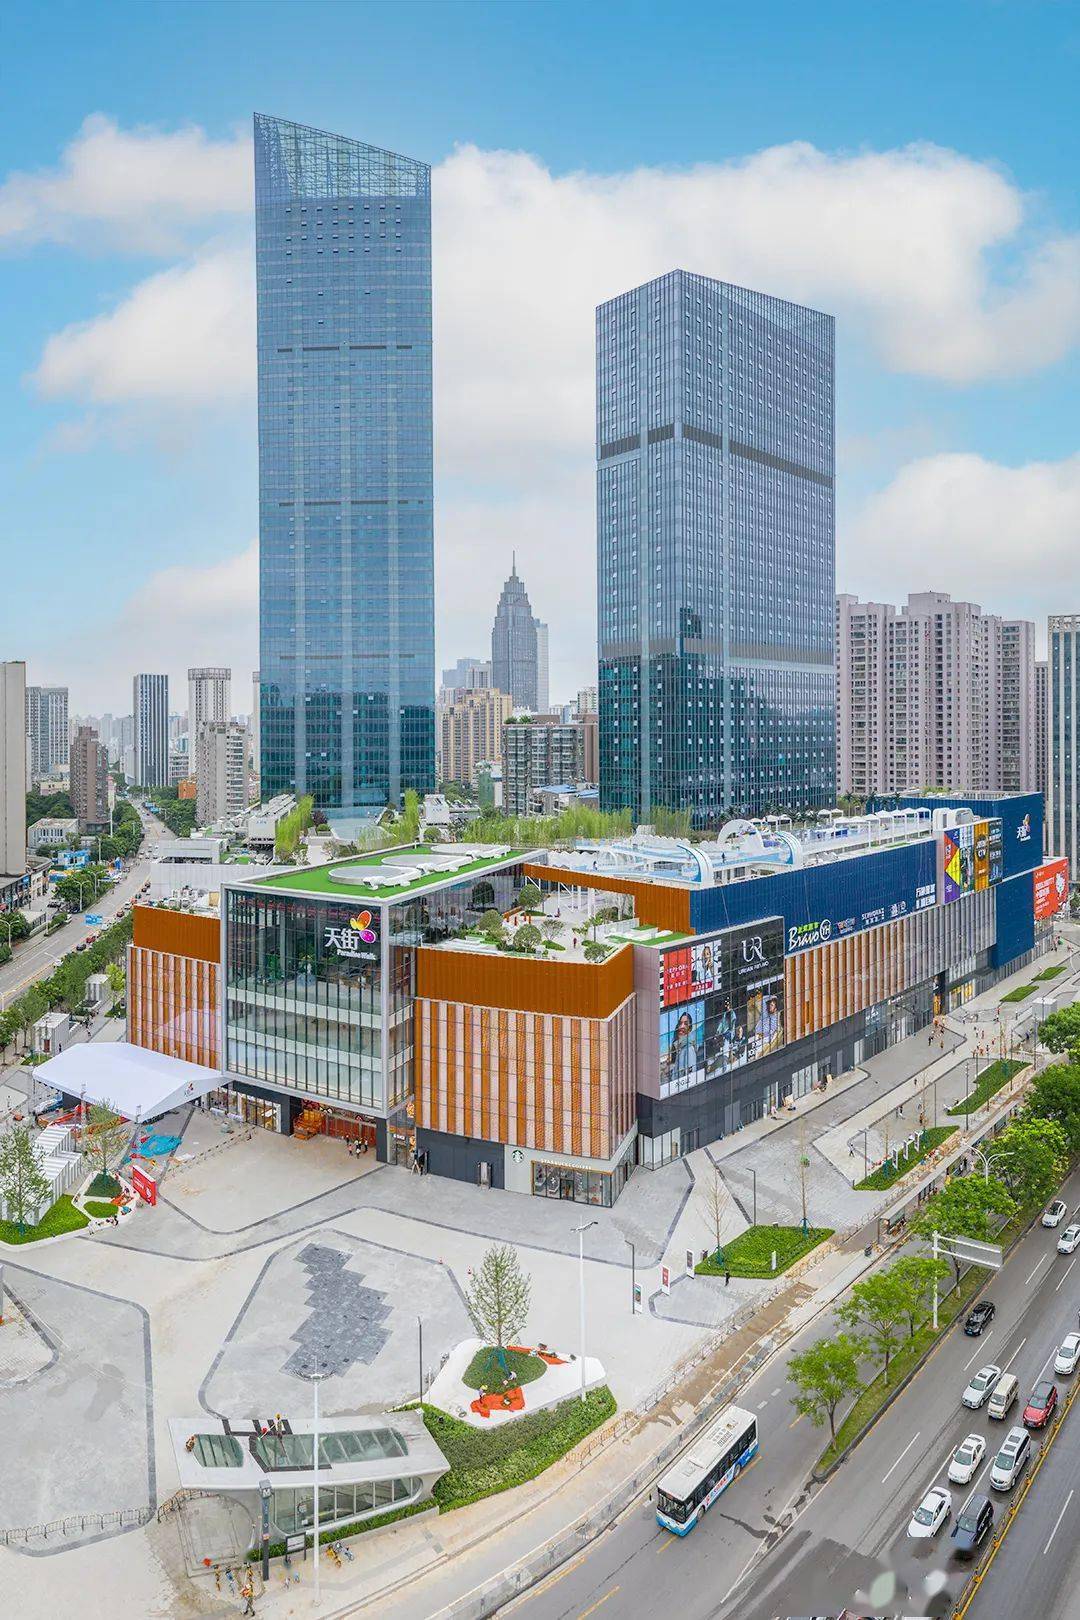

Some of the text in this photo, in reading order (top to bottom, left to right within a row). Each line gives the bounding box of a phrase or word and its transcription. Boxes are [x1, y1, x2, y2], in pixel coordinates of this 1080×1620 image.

[324, 927, 360, 950] 天街
[741, 936, 767, 962] UR
[788, 926, 820, 951] Bravo
